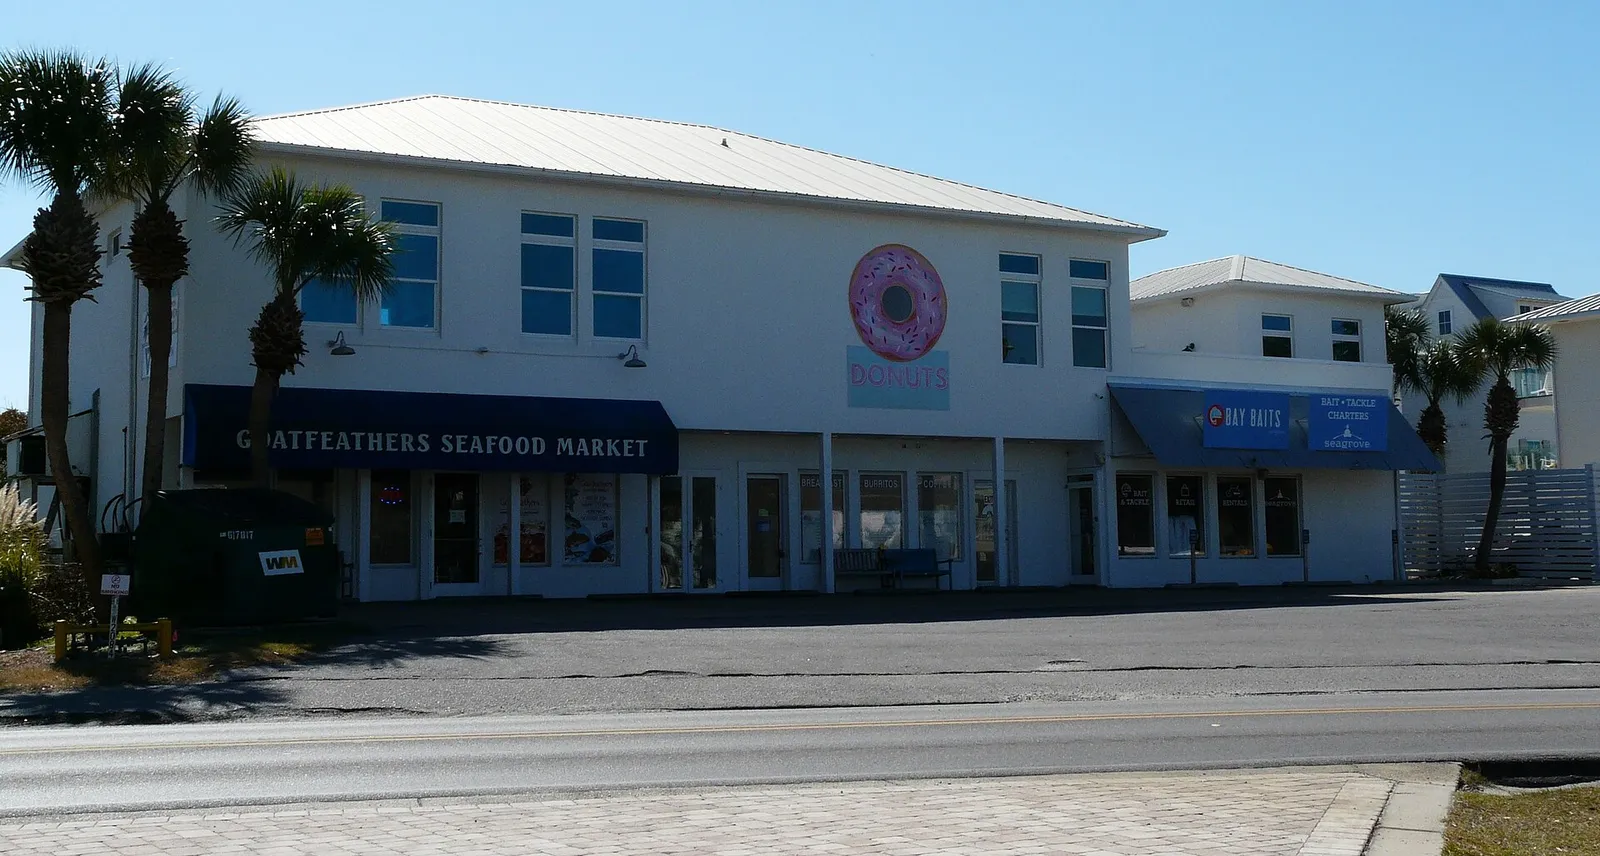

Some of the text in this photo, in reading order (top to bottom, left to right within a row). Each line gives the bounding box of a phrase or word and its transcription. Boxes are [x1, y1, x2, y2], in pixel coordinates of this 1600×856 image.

[851, 362, 949, 391] DONUTS
[1321, 397, 1376, 408] BAIT TACKLE
[1225, 407, 1281, 428] BAY BAITS
[1328, 411, 1369, 421] CHARTERS
[236, 429, 649, 458] GATFEATHERS SEAFOOD MARKET
[1324, 439, 1371, 449] seagrove
[801, 478, 843, 489] BREAST
[864, 479, 899, 489] BURRITOS
[1133, 490, 1148, 498] BAIT
[1175, 498, 1196, 507] RETAIL
[1222, 499, 1249, 507] RENTALS
[265, 556, 298, 570] WM
